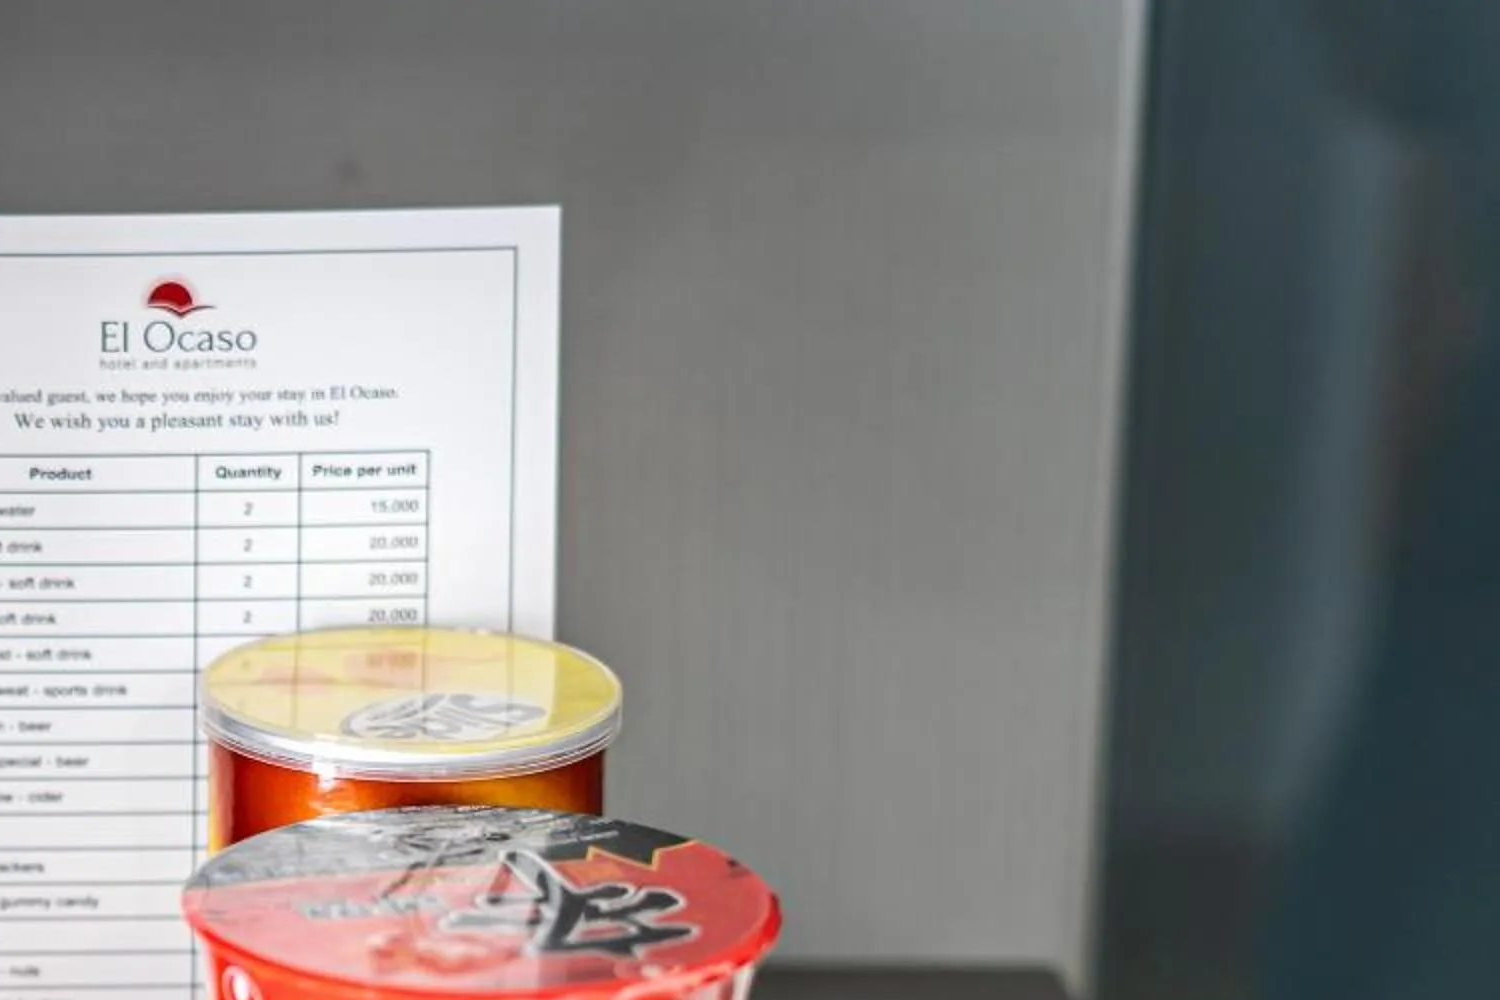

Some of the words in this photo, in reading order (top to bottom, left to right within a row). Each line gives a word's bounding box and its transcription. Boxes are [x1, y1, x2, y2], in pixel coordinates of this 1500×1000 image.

[100, 321, 129, 353] El
[143, 320, 257, 354] Ocaso
[141, 356, 168, 371] and
[174, 356, 258, 373] apartments
[96, 391, 116, 403] we
[120, 388, 157, 406] hope
[161, 390, 190, 406] you
[193, 389, 236, 406] enjoy
[239, 389, 272, 404] your
[276, 388, 306, 404] stay
[311, 386, 326, 400] in
[329, 385, 347, 400] El
[13, 412, 46, 430] We
[50, 411, 92, 430] wish
[97, 414, 131, 433] you
[134, 416, 145, 429] a
[150, 410, 223, 433] pleasant
[229, 412, 264, 430] stay
[269, 409, 308, 427] with
[313, 410, 341, 427] us!
[28, 464, 93, 482] Product
[215, 464, 283, 481] Quantity
[312, 463, 351, 478] Price
[356, 465, 382, 479] per
[386, 462, 418, 477] unit
[243, 501, 254, 517] 2
[6, 540, 44, 554] drink
[243, 537, 253, 553] 2
[8, 576, 35, 590] soft
[38, 576, 76, 590] drink
[243, 574, 253, 589] 2
[20, 612, 57, 626] drink
[242, 610, 252, 625] 2
[25, 648, 53, 661] soft
[56, 648, 93, 661] drink
[91, 684, 129, 697] drink
